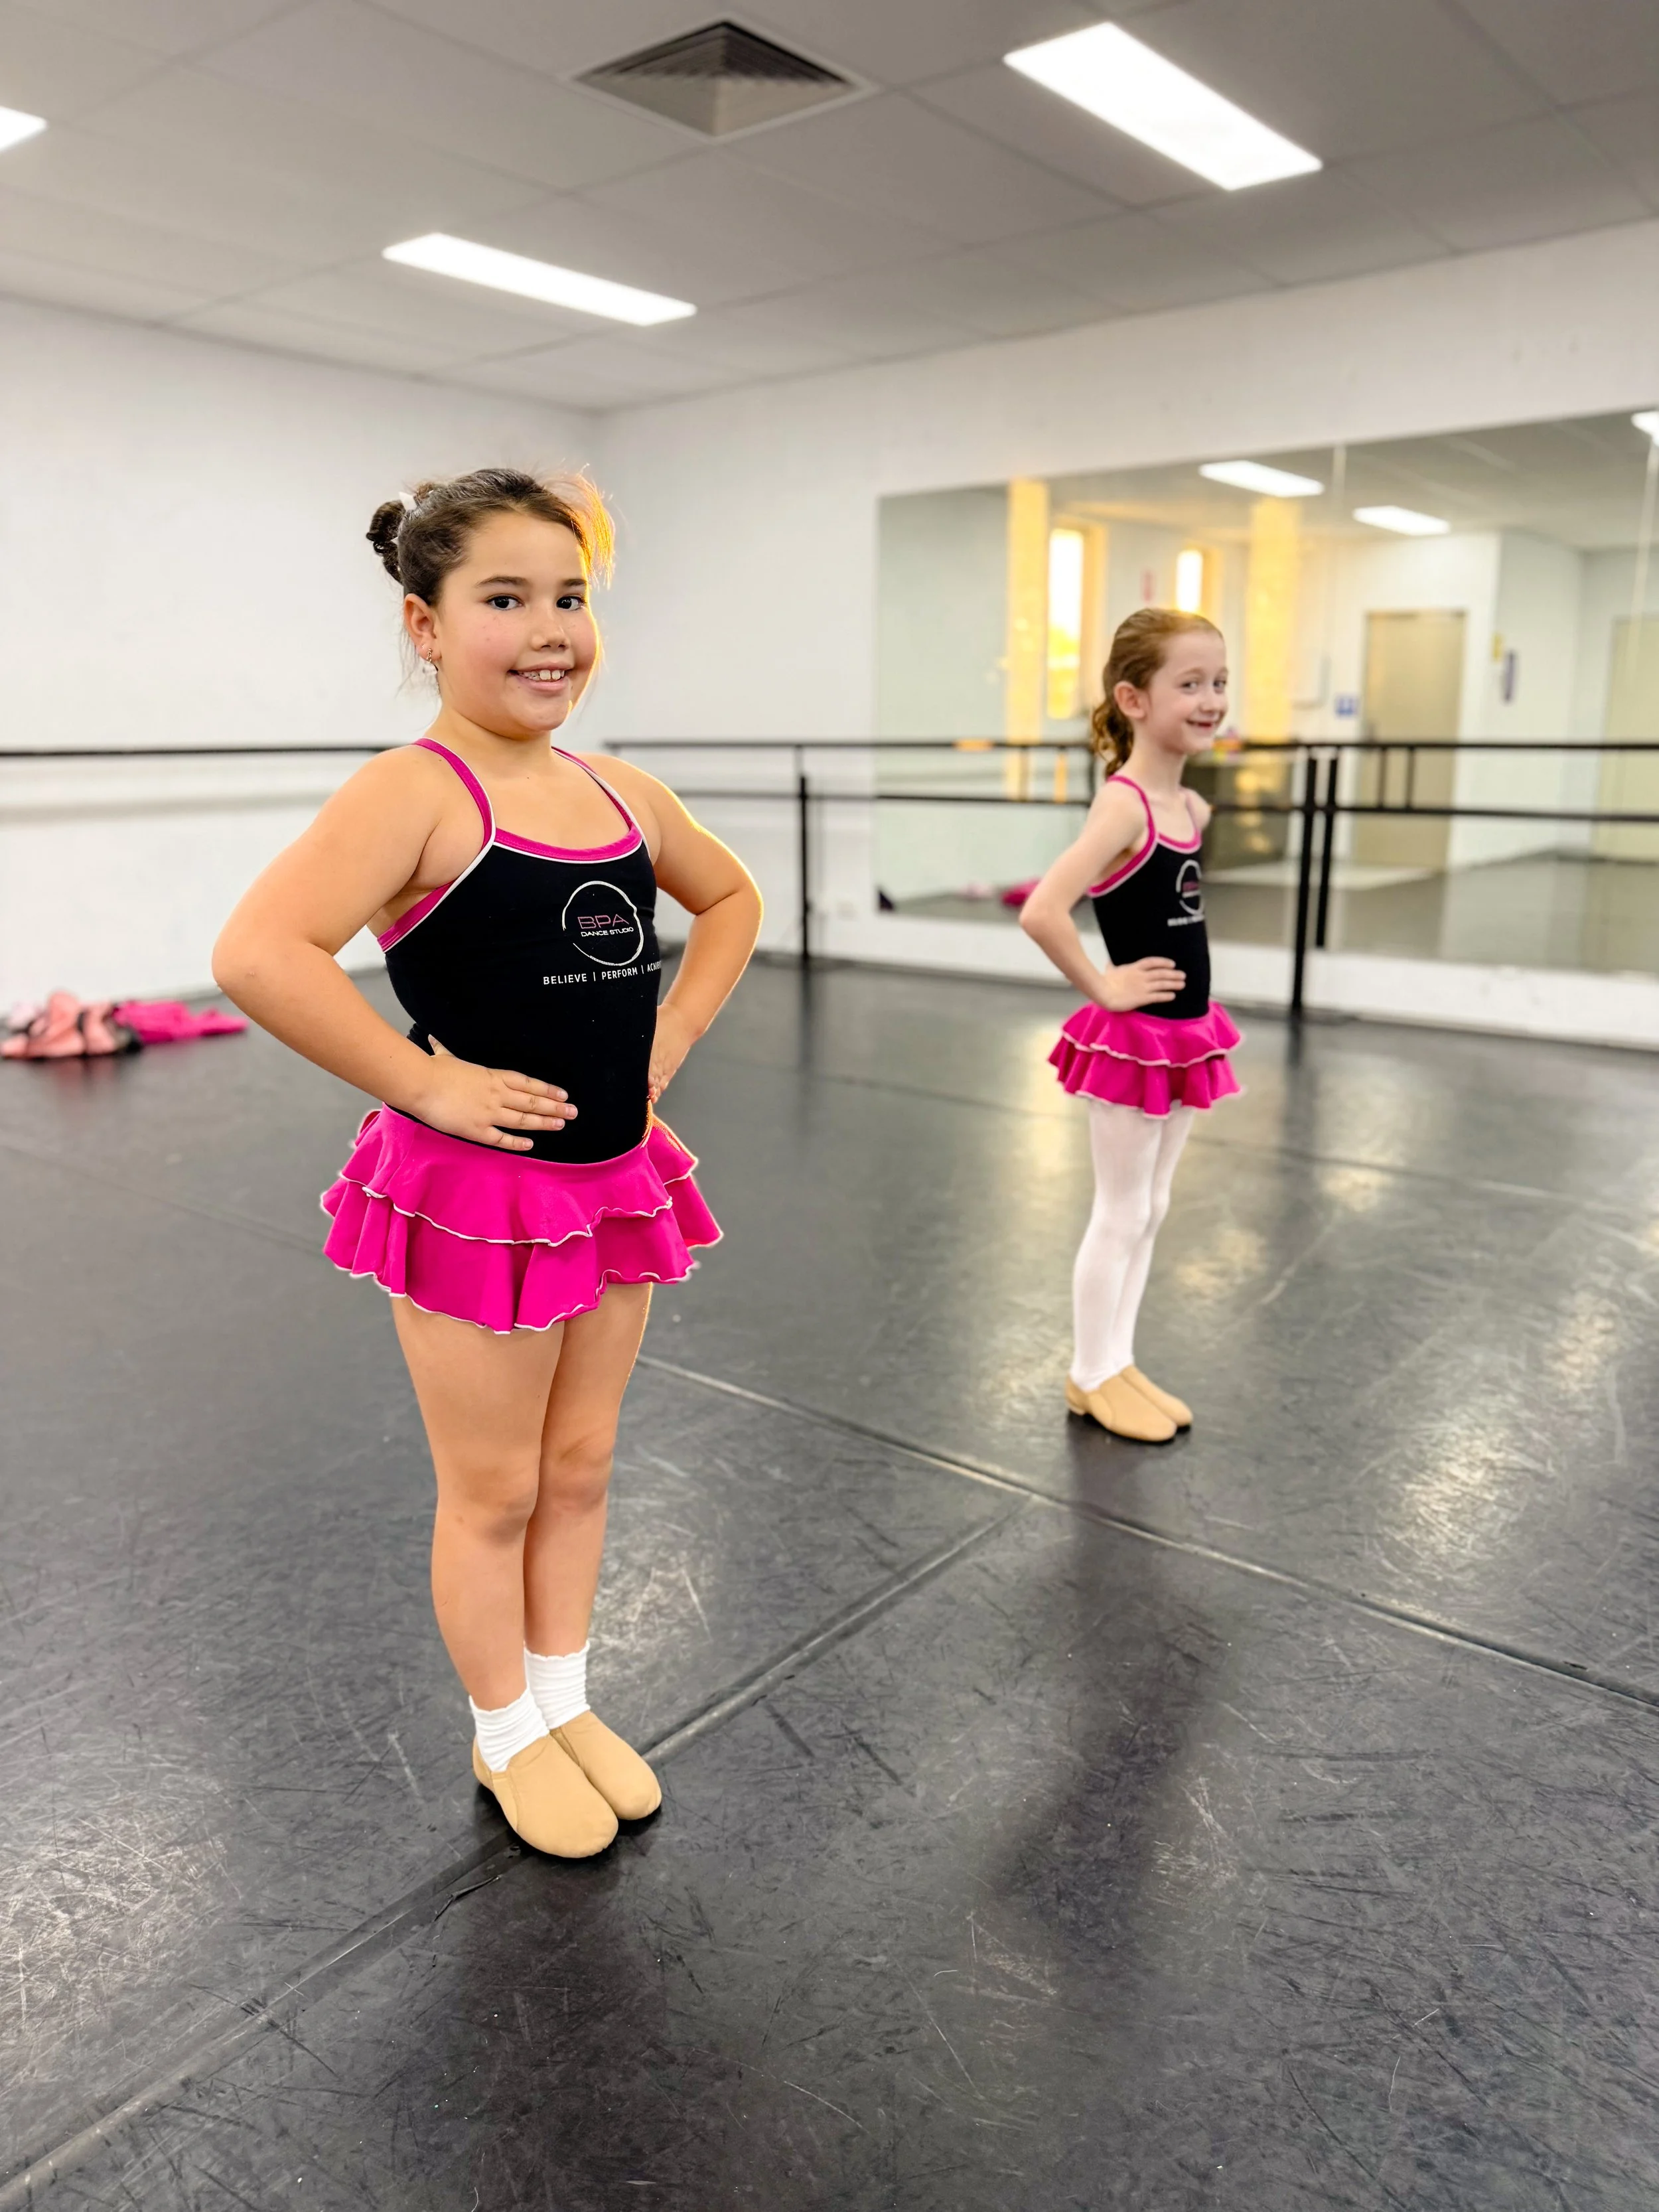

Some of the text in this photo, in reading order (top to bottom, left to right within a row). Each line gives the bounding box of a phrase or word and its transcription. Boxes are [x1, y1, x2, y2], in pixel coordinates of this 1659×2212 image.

[577, 914, 630, 928] BPA
[543, 973, 587, 985] BELIEVE
[601, 967, 638, 980] PERFORM
